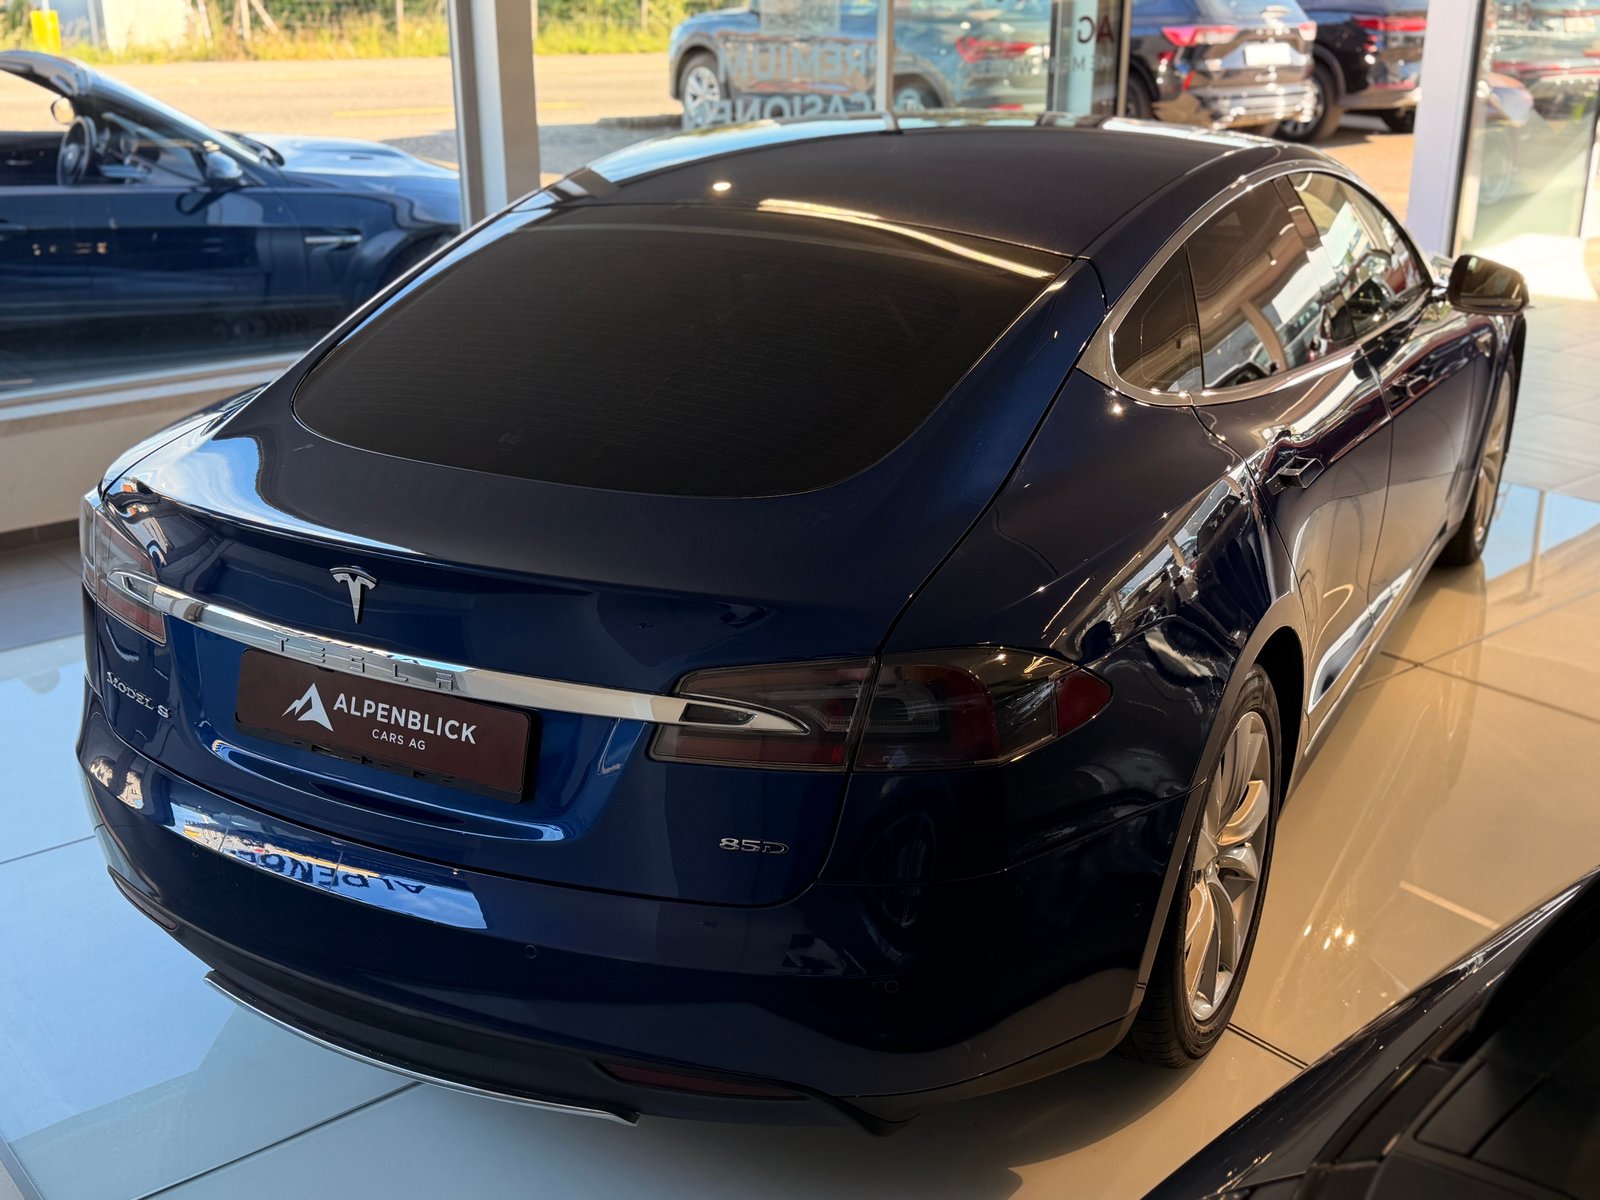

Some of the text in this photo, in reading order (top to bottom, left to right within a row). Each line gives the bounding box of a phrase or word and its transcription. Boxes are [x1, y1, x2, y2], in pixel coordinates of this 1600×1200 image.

[274, 634, 455, 691] TESLA
[106, 671, 170, 718] MODEL S
[333, 692, 478, 745] ALPENBLICK
[371, 728, 427, 751] CARS AG
[718, 837, 790, 854] 85D
